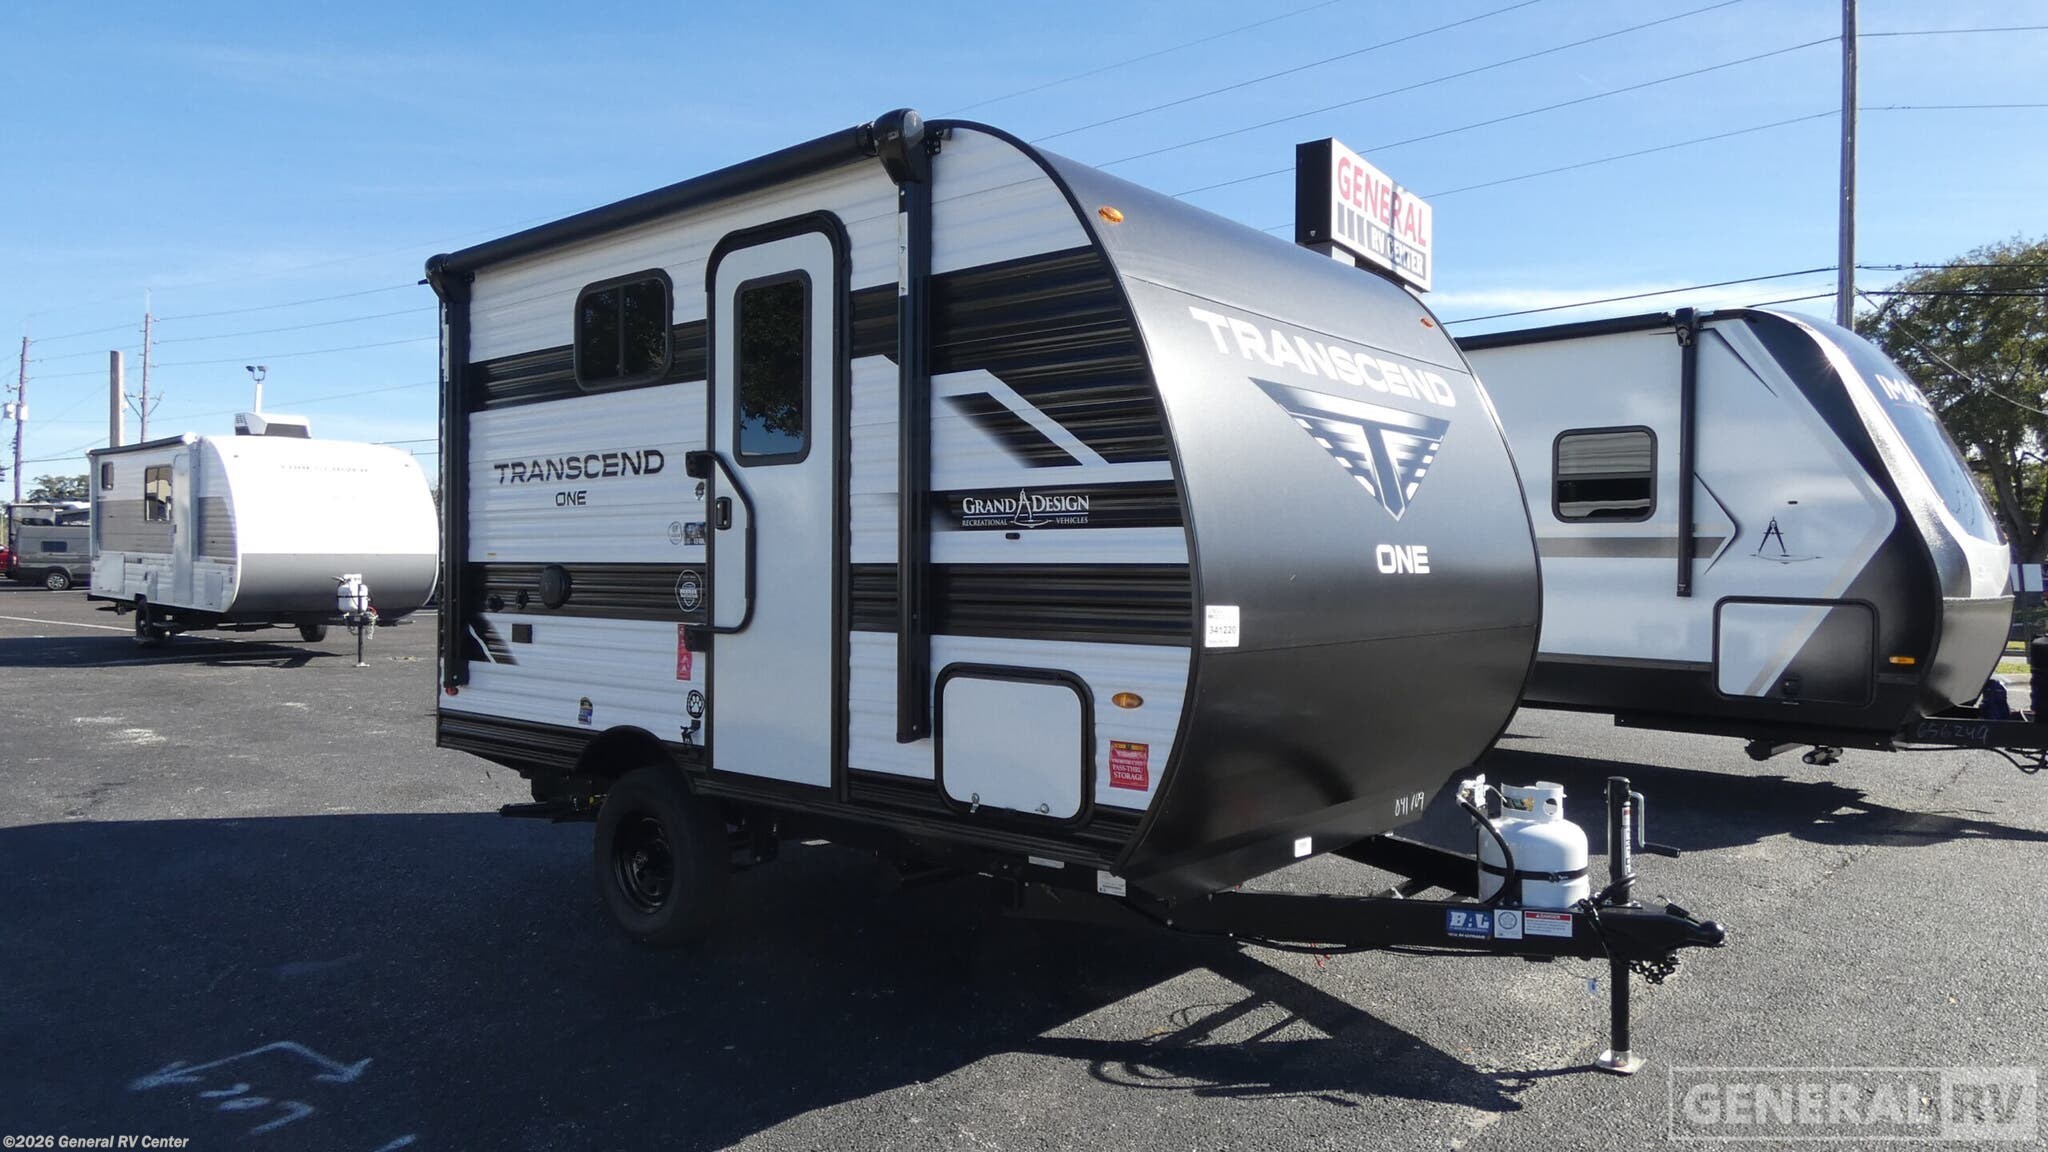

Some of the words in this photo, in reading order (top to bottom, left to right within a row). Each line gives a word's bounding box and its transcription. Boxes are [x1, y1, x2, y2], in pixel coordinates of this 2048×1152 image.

[1338, 156, 1427, 248] GENERAL
[1371, 229, 1386, 254] RV
[1188, 306, 1456, 408] TRANSCEND
[493, 449, 665, 485] TRANSCEND
[555, 490, 587, 507] ONE
[962, 497, 1017, 514] GRAND
[1031, 495, 1090, 512] DESIGN
[961, 518, 1008, 527] RECREATIONAL
[1055, 515, 1089, 525] VEHICLES
[1375, 544, 1430, 575] ONE
[1113, 771, 1145, 781] STORAGE
